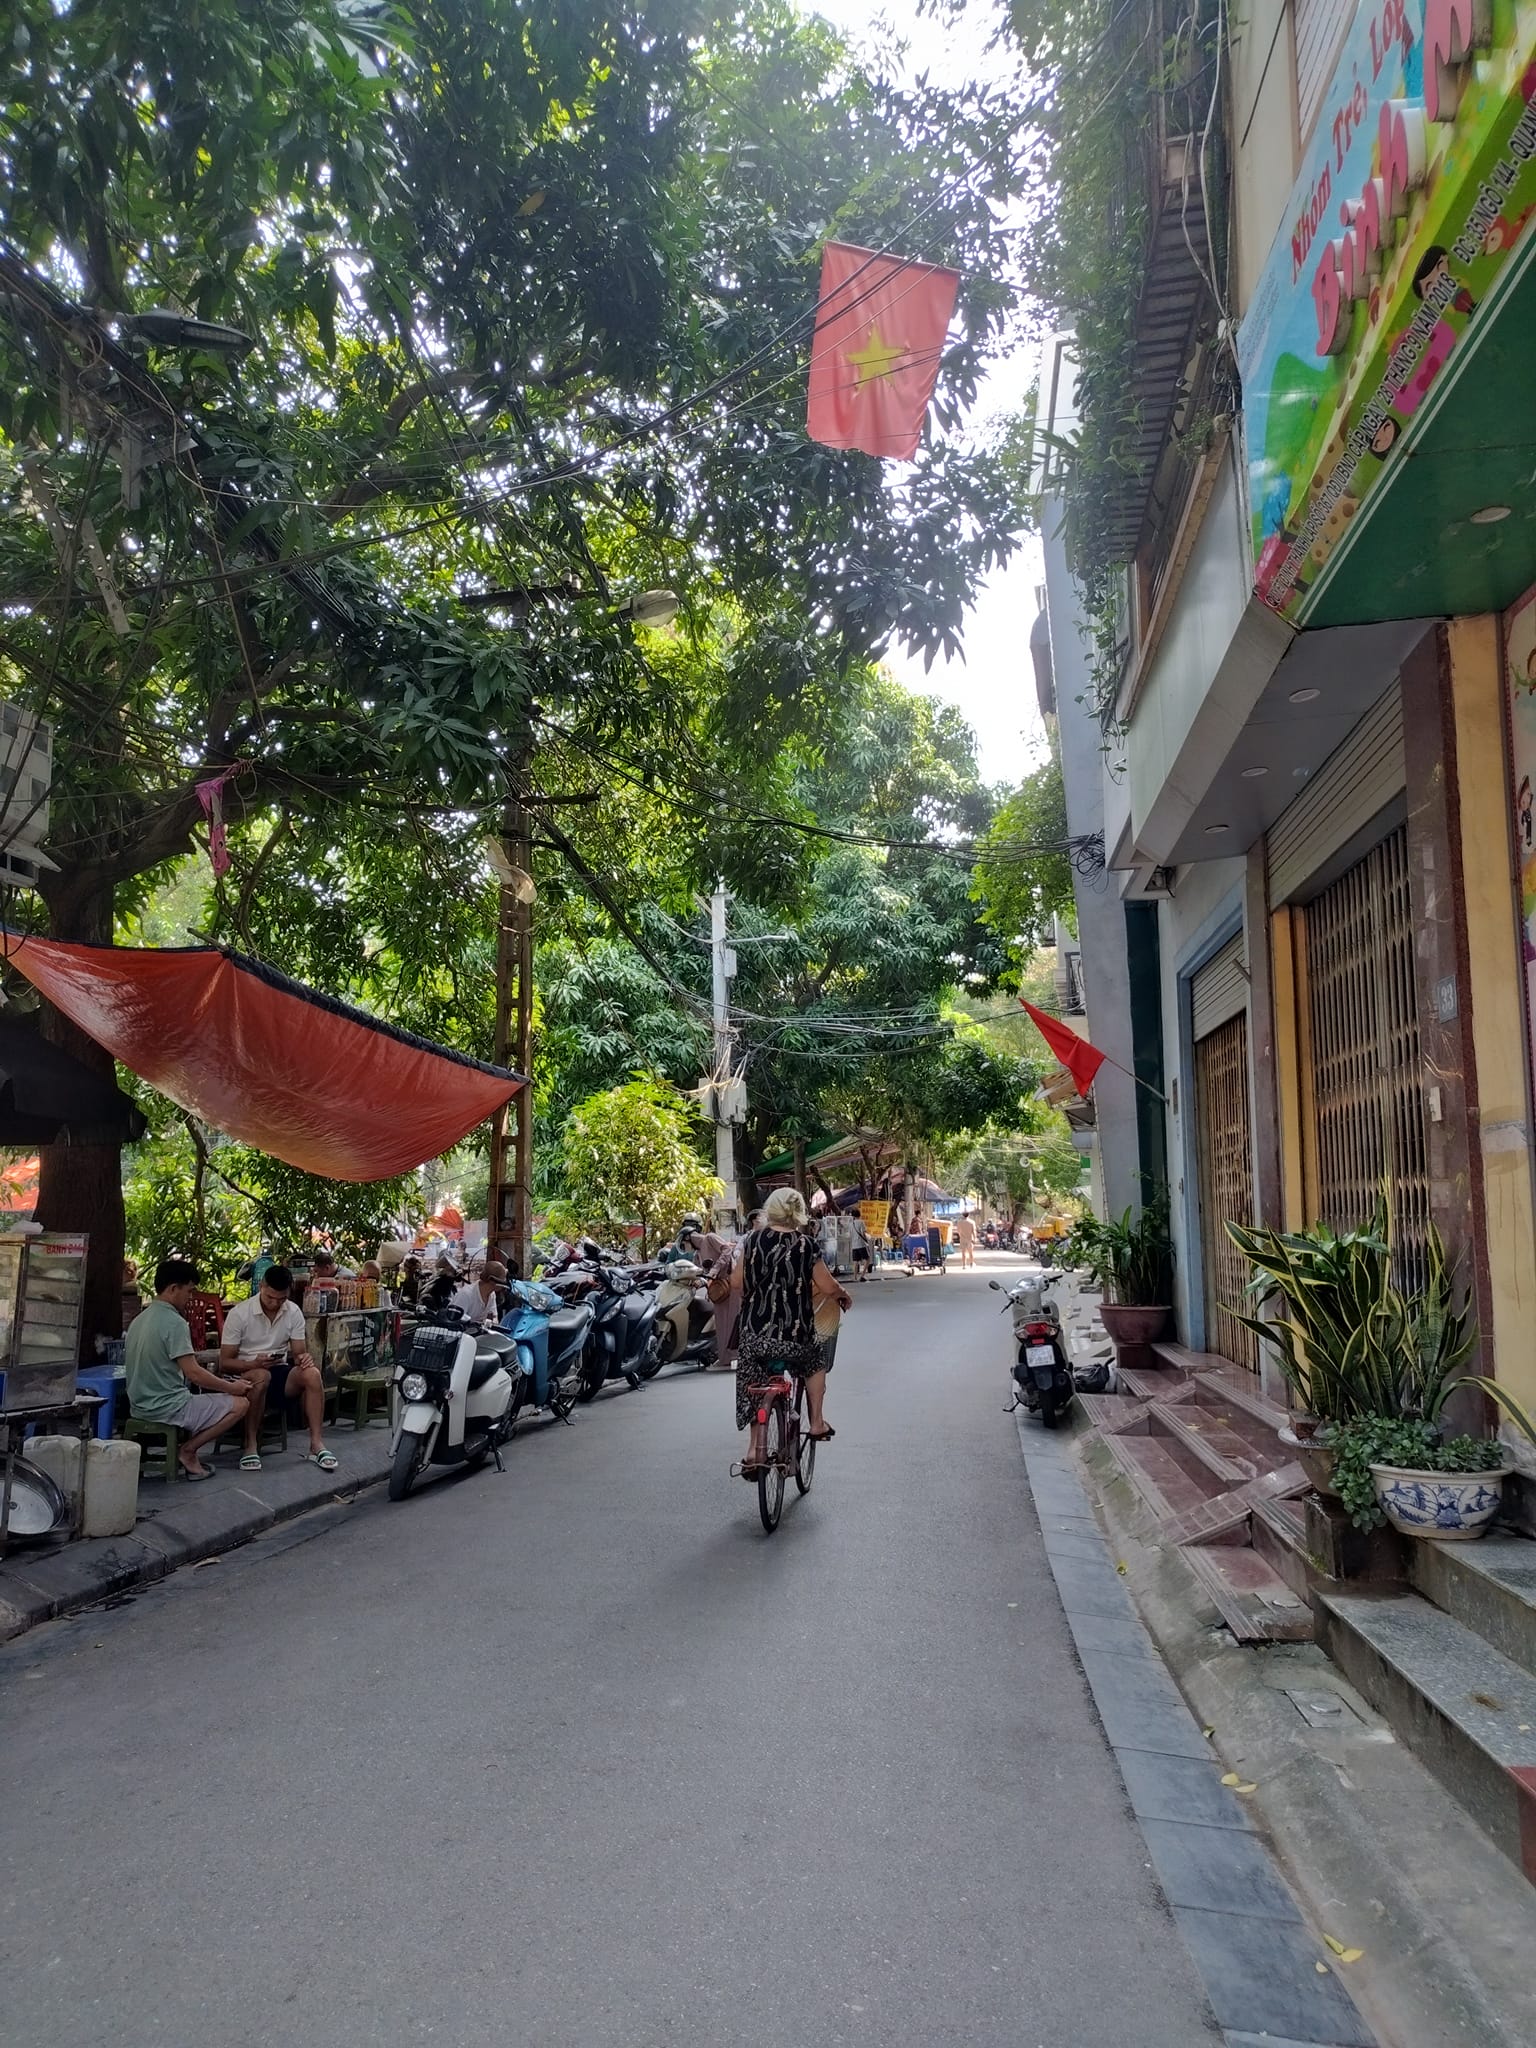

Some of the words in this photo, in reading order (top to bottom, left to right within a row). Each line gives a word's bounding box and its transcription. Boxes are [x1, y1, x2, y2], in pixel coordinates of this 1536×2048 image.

[1493, 161, 1516, 192] 144
[1291, 160, 1332, 285] Nhóm
[1429, 272, 1457, 311] 2018
[1405, 332, 1423, 349] 9
[1411, 302, 1441, 342] NĂM
[1384, 343, 1418, 391] THÁNG
[1377, 386, 1395, 406] 28
[1360, 399, 1387, 439] NGÀY
[1440, 982, 1453, 1013] 33
